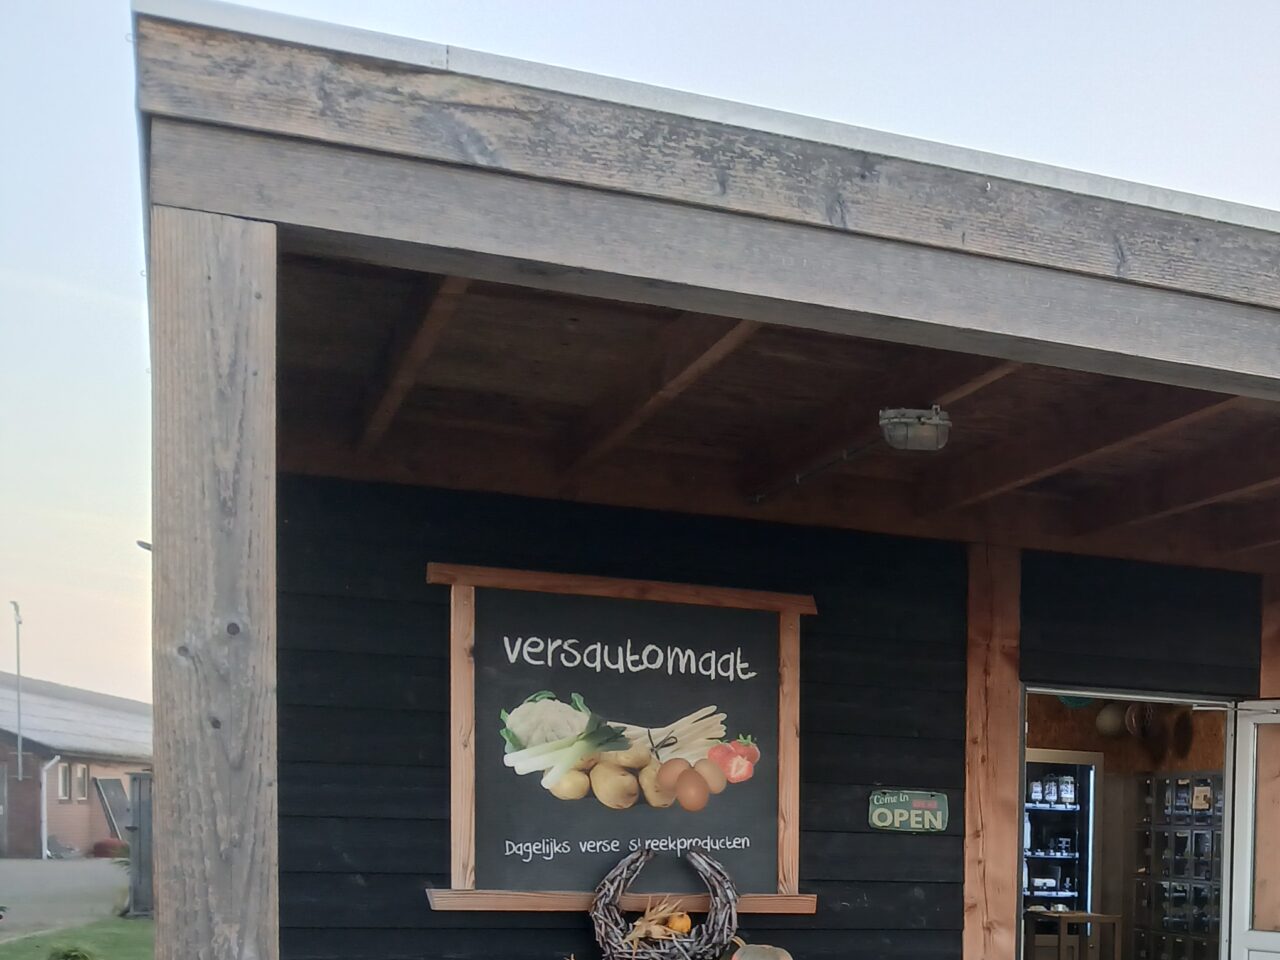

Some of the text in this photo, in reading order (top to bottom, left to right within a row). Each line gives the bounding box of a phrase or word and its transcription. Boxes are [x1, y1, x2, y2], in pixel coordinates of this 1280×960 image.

[503, 636, 758, 682] versautomaat
[873, 794, 898, 805] Come
[872, 807, 942, 829] OPEN
[504, 838, 571, 862] Dagelijks
[579, 839, 620, 853] verse
